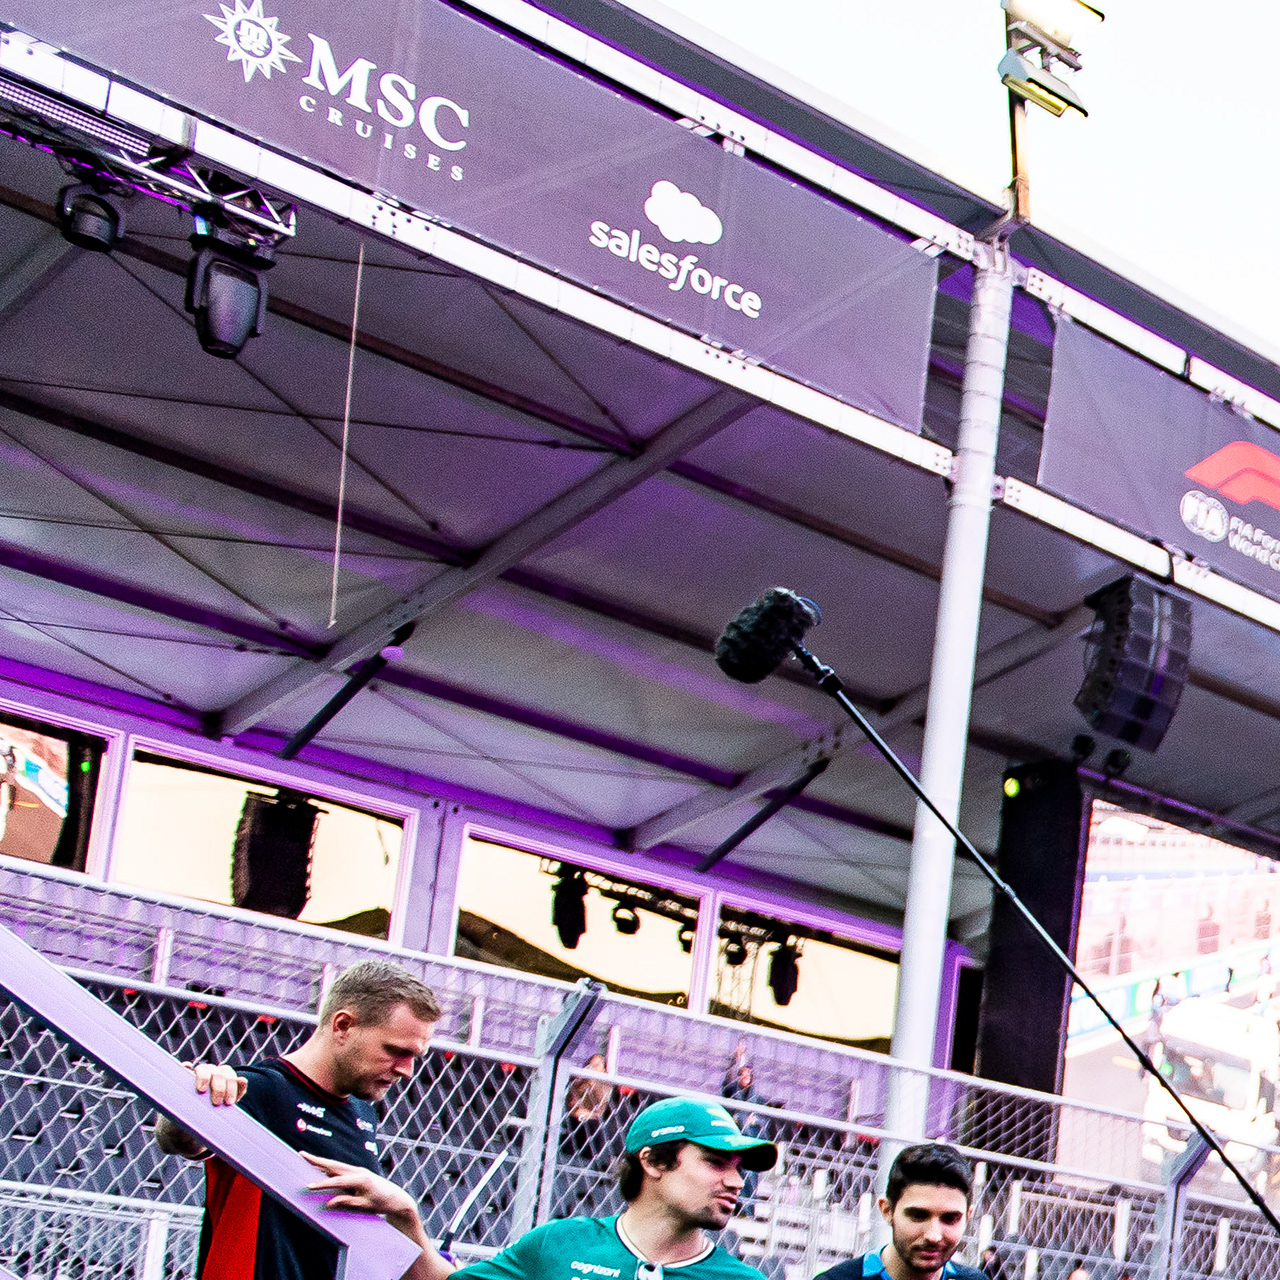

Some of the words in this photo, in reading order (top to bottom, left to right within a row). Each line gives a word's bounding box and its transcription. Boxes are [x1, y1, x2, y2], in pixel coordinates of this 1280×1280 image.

[299, 95, 464, 182] CRUISES
[301, 32, 470, 152] MSC
[588, 218, 762, 319] salesforce
